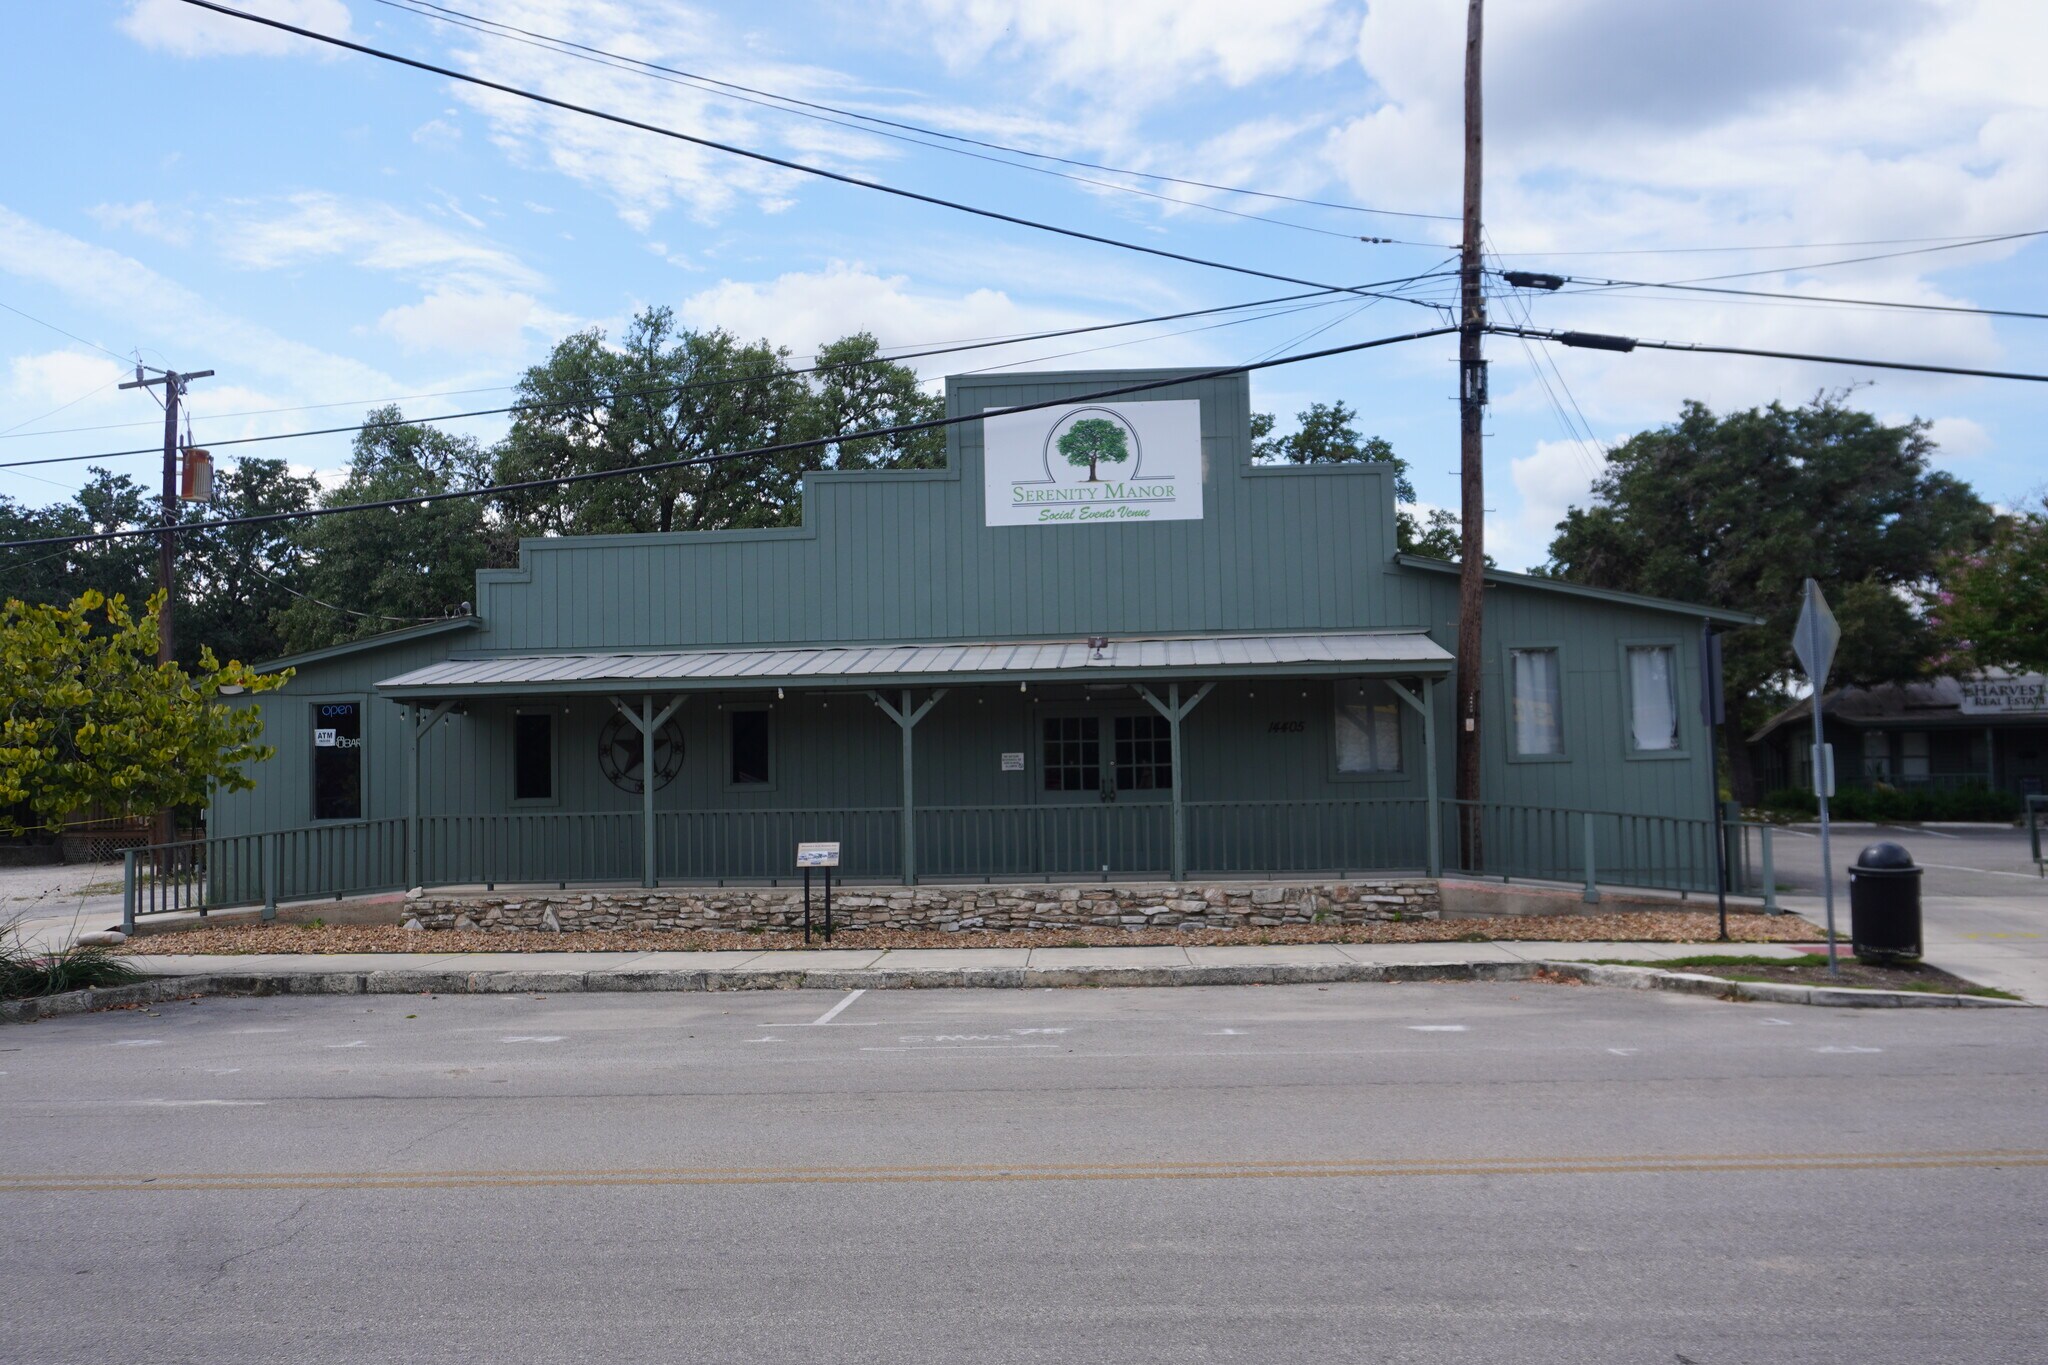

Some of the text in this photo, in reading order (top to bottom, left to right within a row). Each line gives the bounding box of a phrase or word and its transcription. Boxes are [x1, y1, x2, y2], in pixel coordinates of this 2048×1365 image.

[1013, 483, 1175, 502] SERENITY MANOR
[1038, 505, 1151, 521] Social Events Venue
[1975, 684, 2045, 696] HARVEST
[1975, 697, 2001, 705] REAL
[322, 705, 352, 717] open
[1268, 721, 1305, 733] 14405
